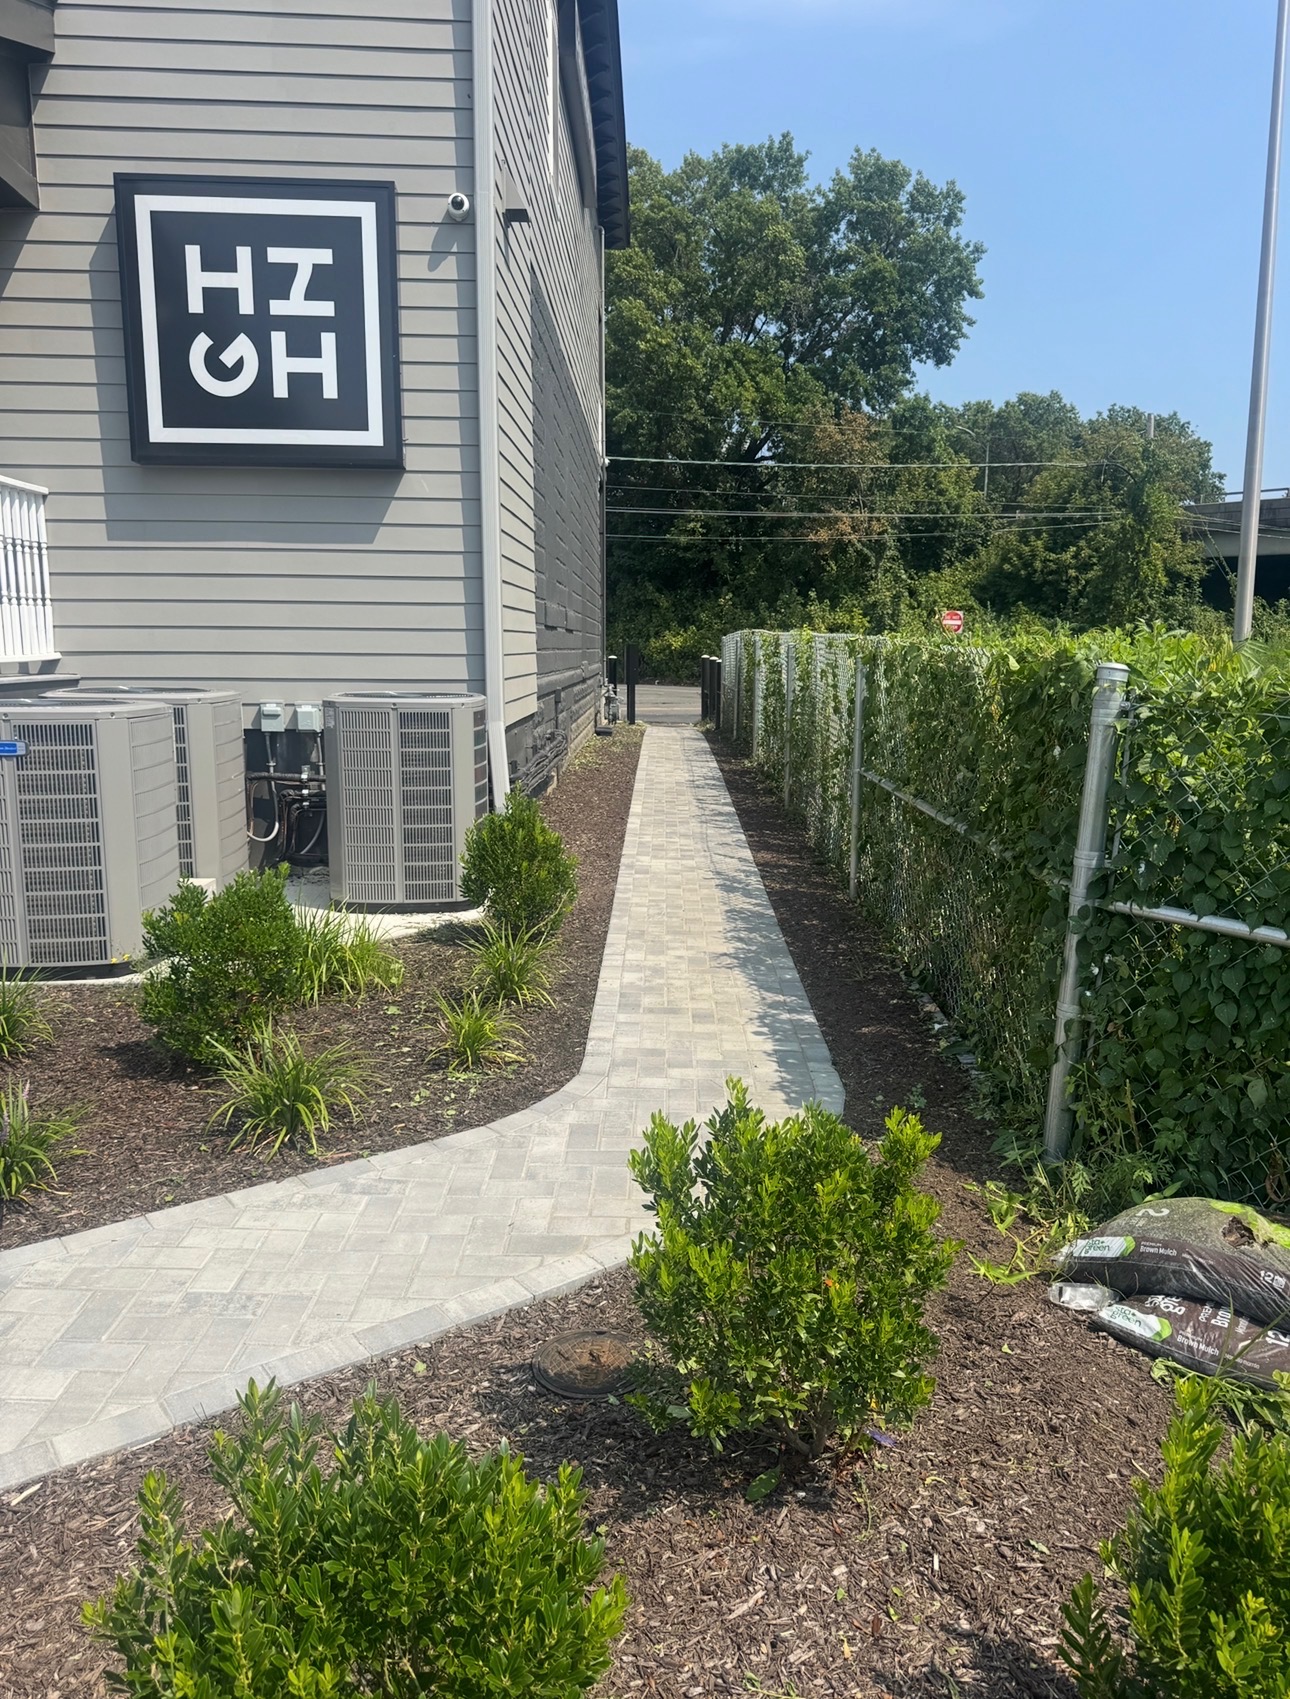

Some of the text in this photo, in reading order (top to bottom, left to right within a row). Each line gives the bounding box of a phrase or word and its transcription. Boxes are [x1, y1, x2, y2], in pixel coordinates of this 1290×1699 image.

[1139, 1245, 1177, 1256] Brown Mulch
[1177, 1334, 1199, 1349] Brown
[1199, 1342, 1220, 1356] Mulch
[1265, 1330, 1290, 1347] 12
